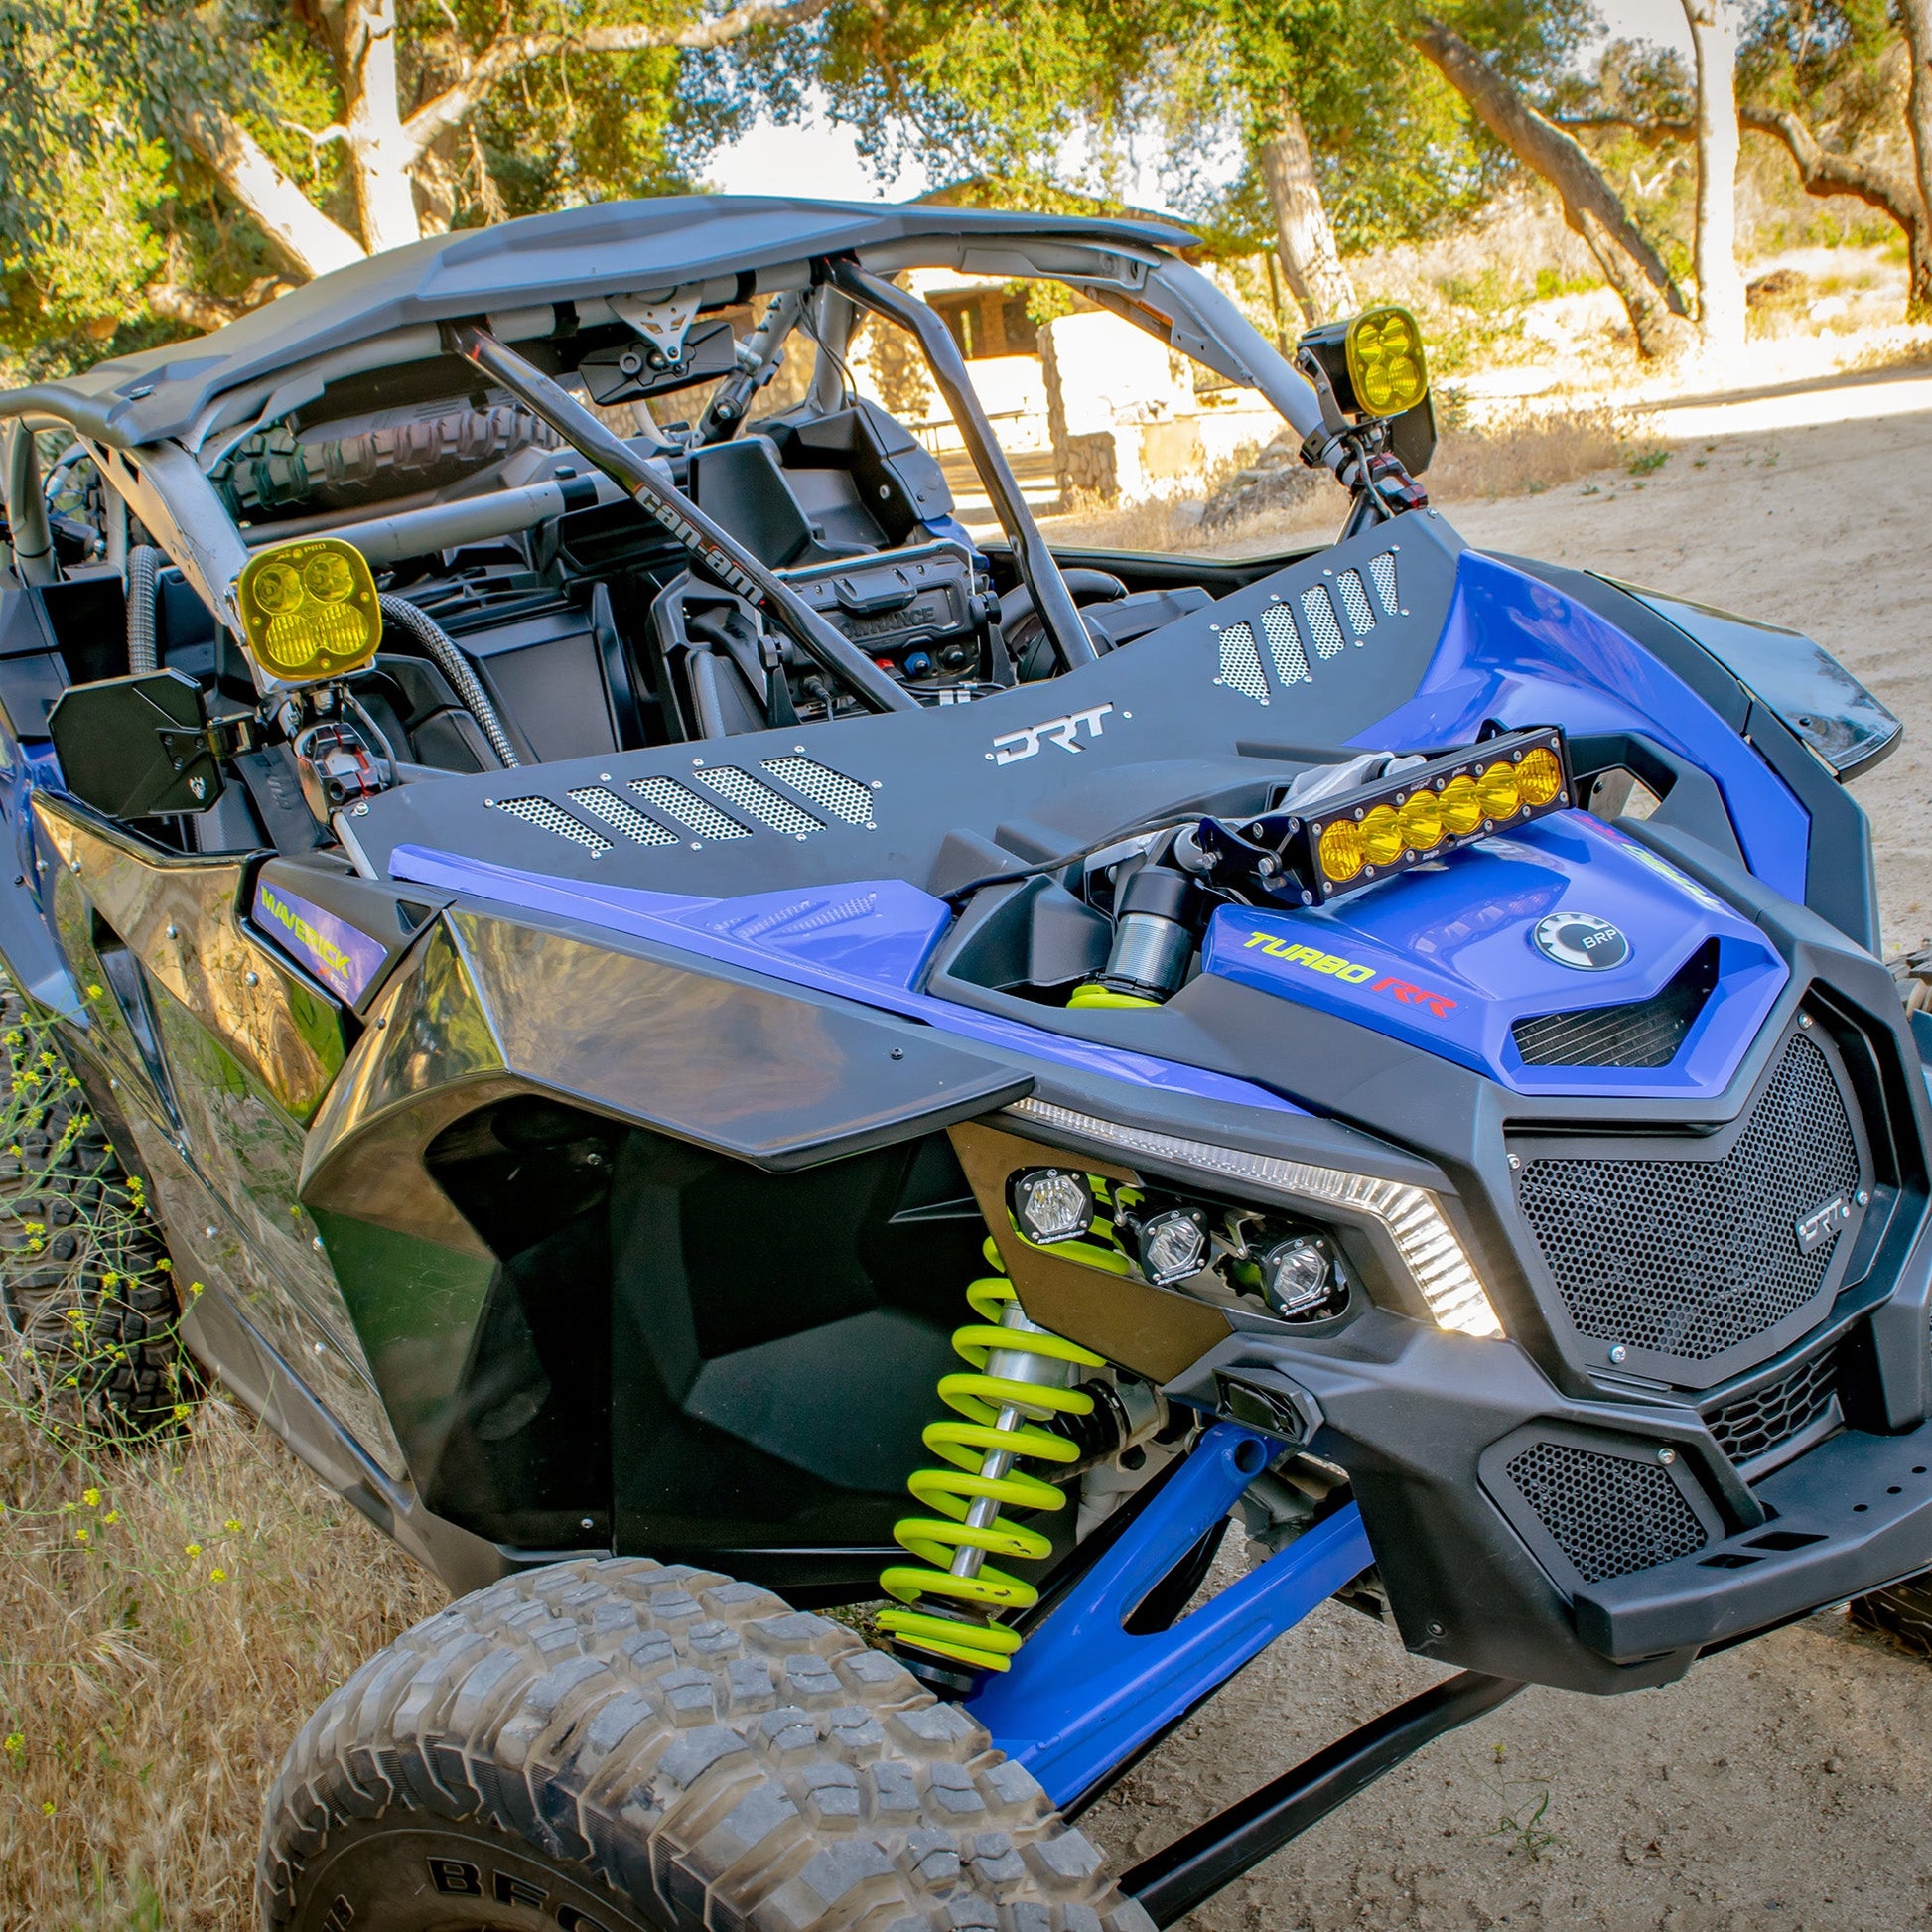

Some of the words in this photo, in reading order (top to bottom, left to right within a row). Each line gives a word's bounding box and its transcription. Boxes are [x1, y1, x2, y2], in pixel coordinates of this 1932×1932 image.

[633, 481, 764, 606] can-am
[993, 702, 1113, 766] DRT
[261, 885, 351, 980] MAVERICK
[1582, 929, 1617, 949] BRP
[1242, 931, 1377, 984] TURBO
[1371, 976, 1457, 1019] RR
[1805, 1196, 1843, 1242] DRT
